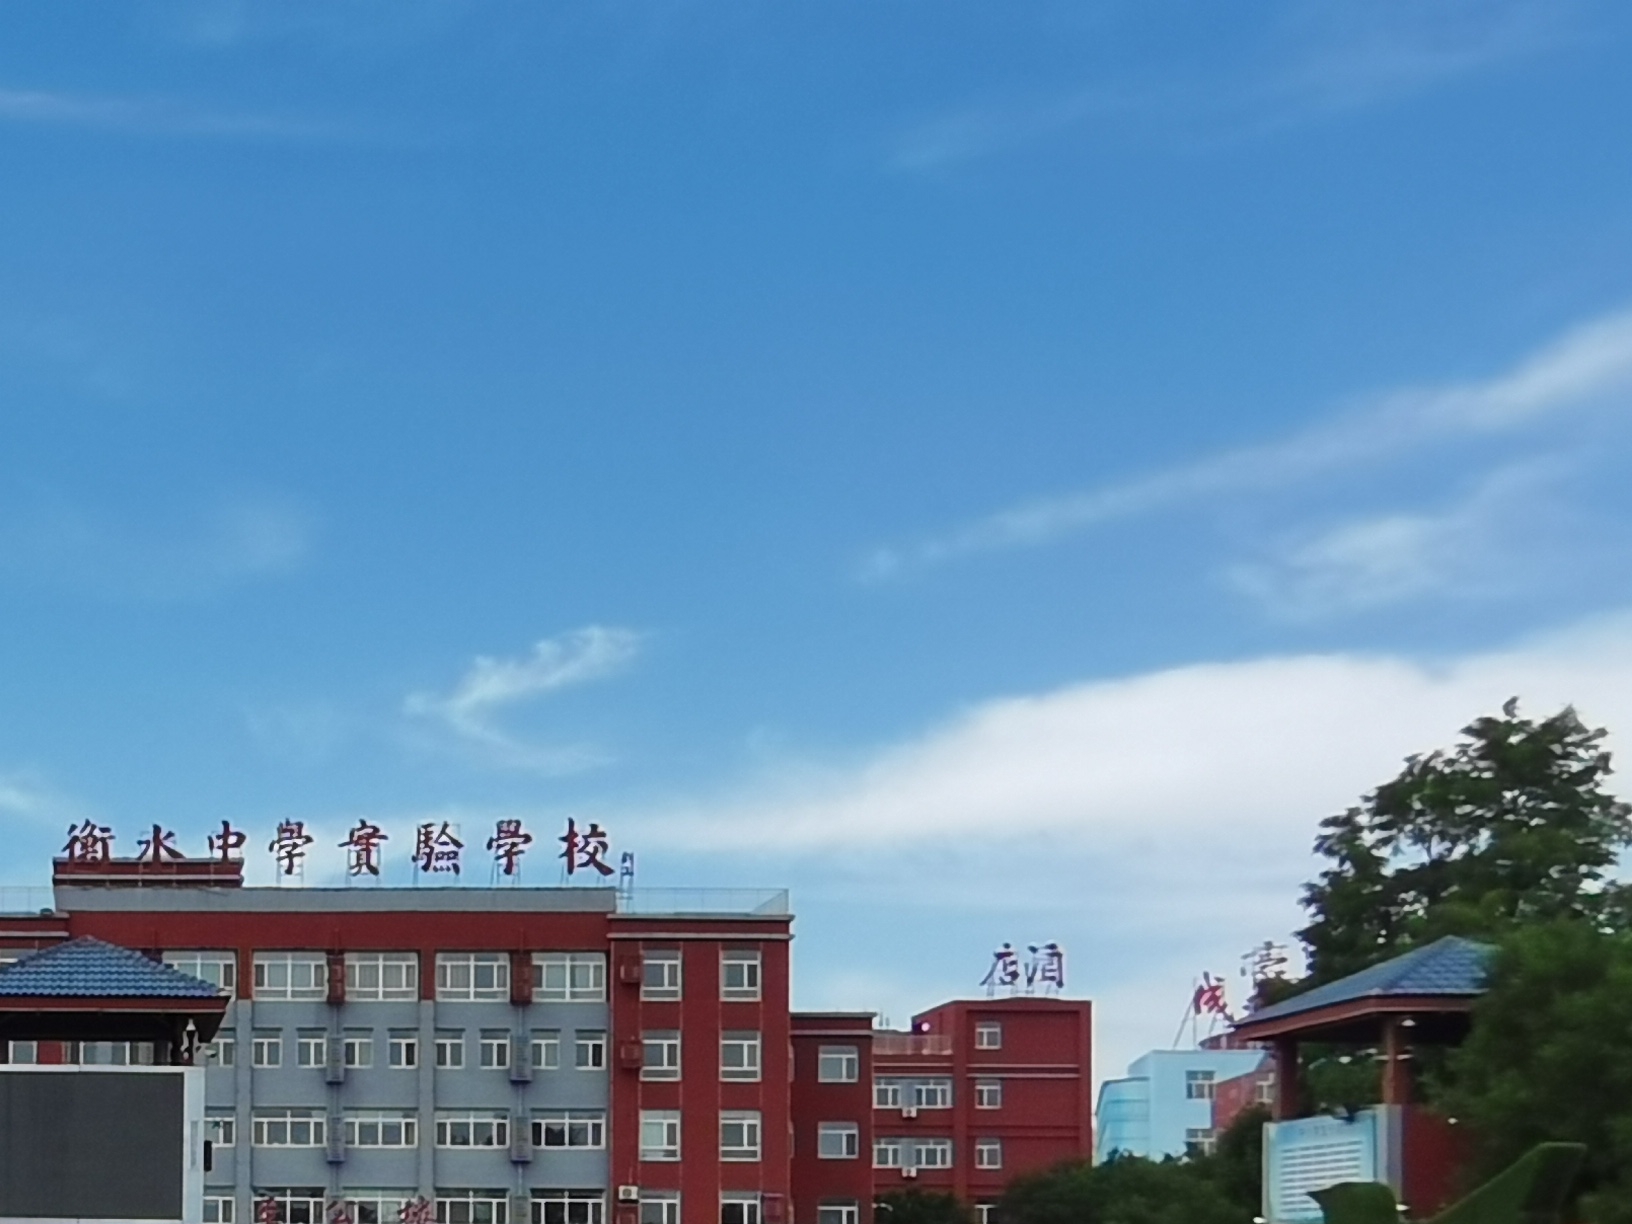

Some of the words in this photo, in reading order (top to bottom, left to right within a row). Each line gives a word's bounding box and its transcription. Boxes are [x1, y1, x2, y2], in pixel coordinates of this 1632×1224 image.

[60, 817, 616, 877] 衡水中學實驗學校
